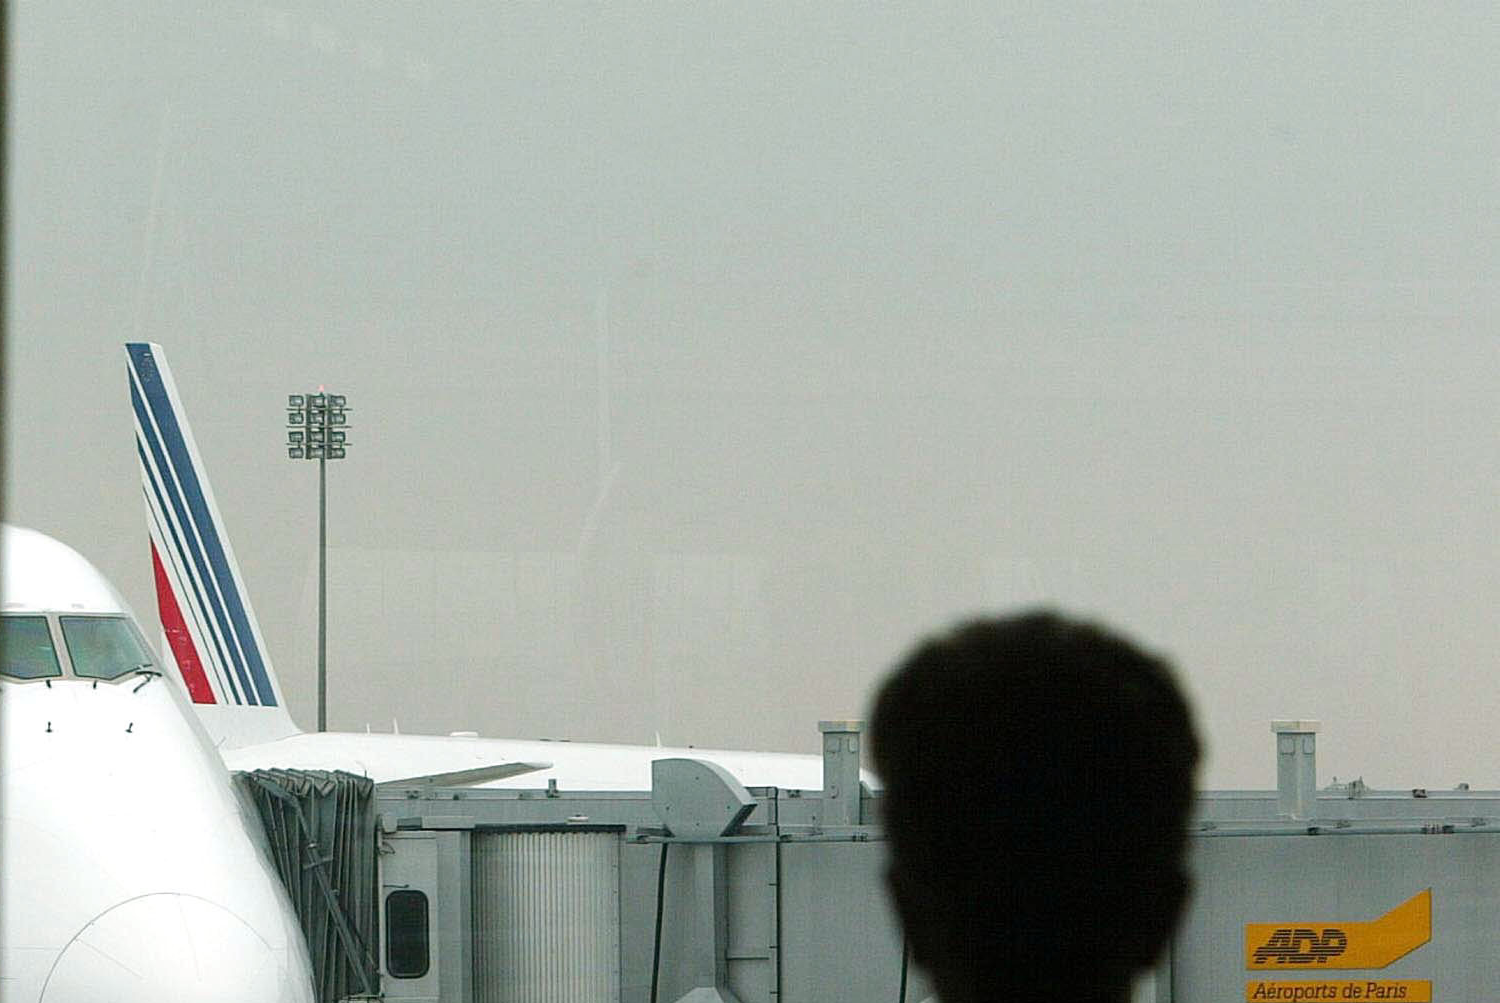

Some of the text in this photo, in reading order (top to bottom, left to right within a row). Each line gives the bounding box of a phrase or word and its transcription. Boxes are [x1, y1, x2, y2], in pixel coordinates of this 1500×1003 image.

[1253, 928, 1347, 964] ADP
[1252, 982, 1408, 1003] Aéroports de Paris
